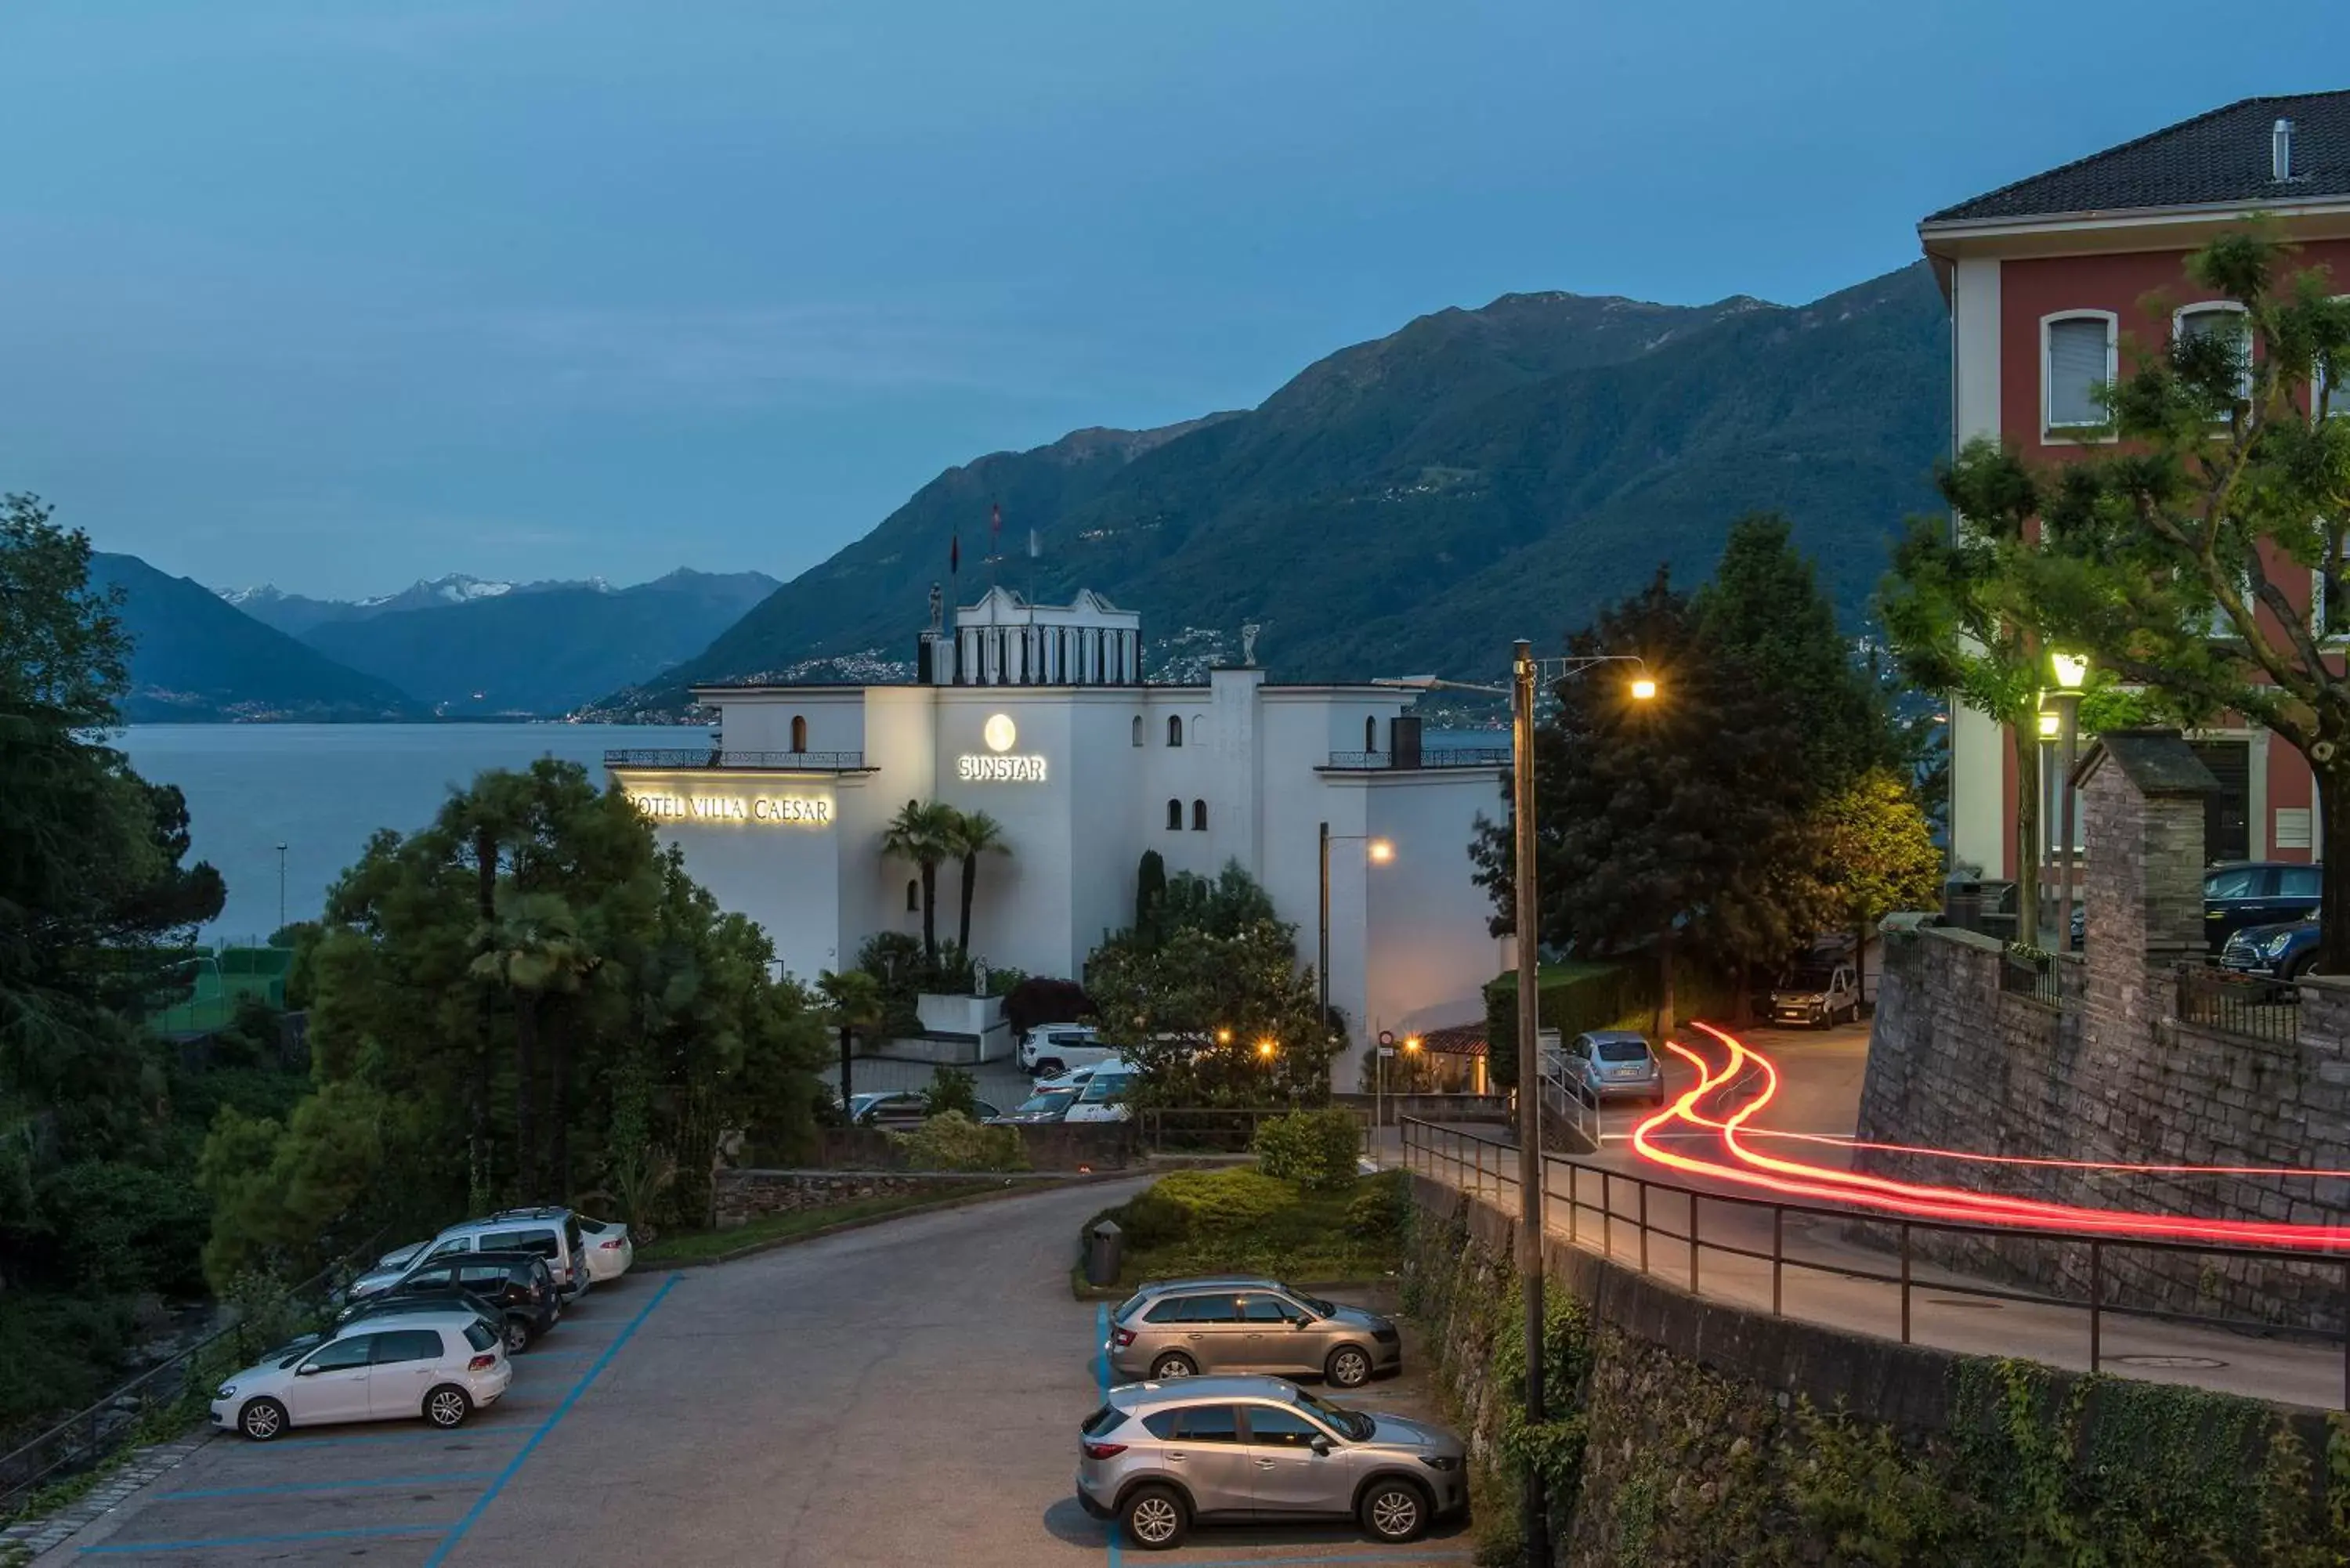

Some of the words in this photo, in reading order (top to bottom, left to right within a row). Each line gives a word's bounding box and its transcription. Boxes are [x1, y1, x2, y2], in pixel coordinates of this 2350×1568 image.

[959, 757, 1043, 779] SUNSTAR
[689, 798, 743, 818] VILLA
[754, 799, 828, 822] CAESAR
